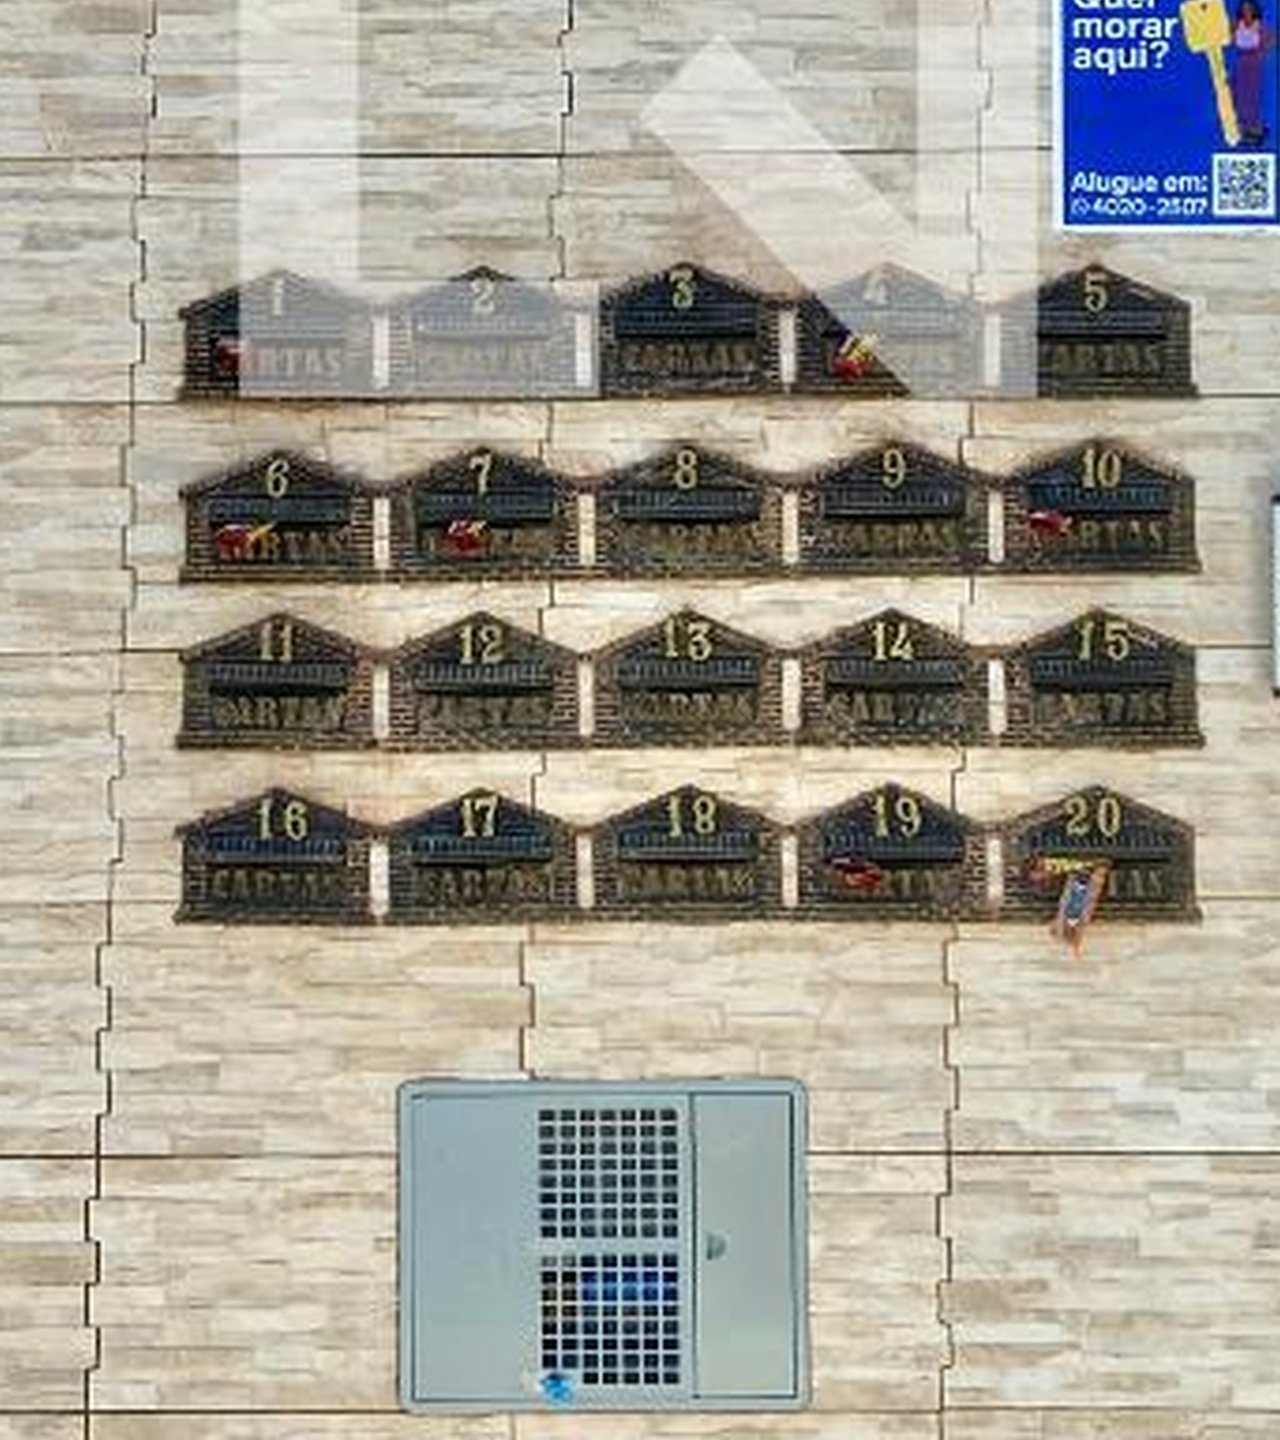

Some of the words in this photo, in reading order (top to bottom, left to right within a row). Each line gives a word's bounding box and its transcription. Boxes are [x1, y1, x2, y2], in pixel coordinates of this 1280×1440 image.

[1072, 16, 1178, 39] morar
[1072, 41, 1170, 75] aqui?
[1071, 171, 1159, 196] Alugue
[471, 280, 498, 313] 2
[1082, 271, 1109, 313] 5
[266, 459, 290, 498] 6
[469, 453, 492, 495] 7
[673, 449, 699, 490] 8
[881, 448, 907, 489] 9
[1081, 448, 1122, 489] 10
[258, 622, 294, 663] 11
[458, 623, 505, 664] 12
[871, 621, 915, 662] 14
[1077, 620, 1130, 661] 15
[257, 797, 309, 841] 16
[459, 794, 500, 839] 17
[667, 795, 716, 838] 18
[871, 796, 922, 839] 19
[1065, 795, 1121, 838] 20
